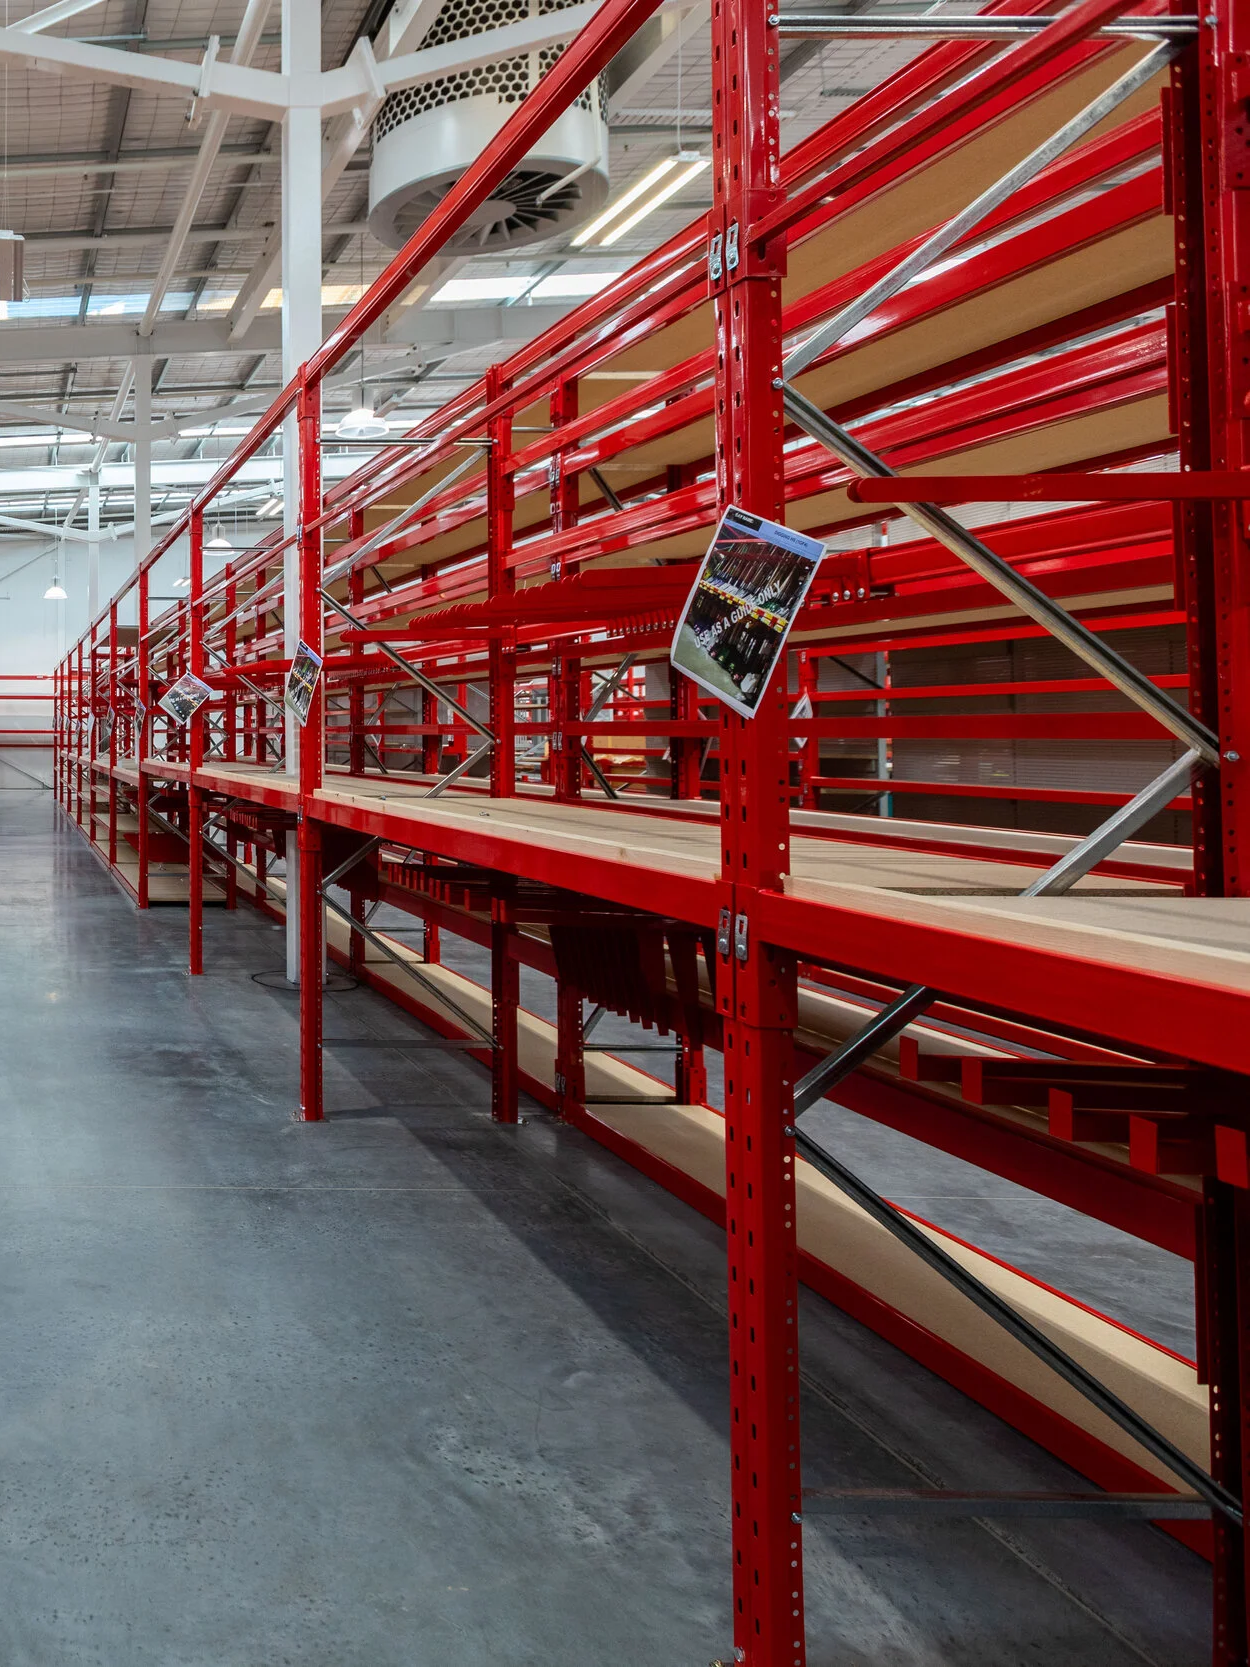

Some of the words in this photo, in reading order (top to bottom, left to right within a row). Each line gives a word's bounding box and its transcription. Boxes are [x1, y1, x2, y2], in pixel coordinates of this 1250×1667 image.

[694, 629, 711, 649] USE
[711, 621, 723, 637] AS
[723, 616, 731, 630] A
[730, 598, 758, 624] GUIDE
[758, 580, 781, 606] ONLY
